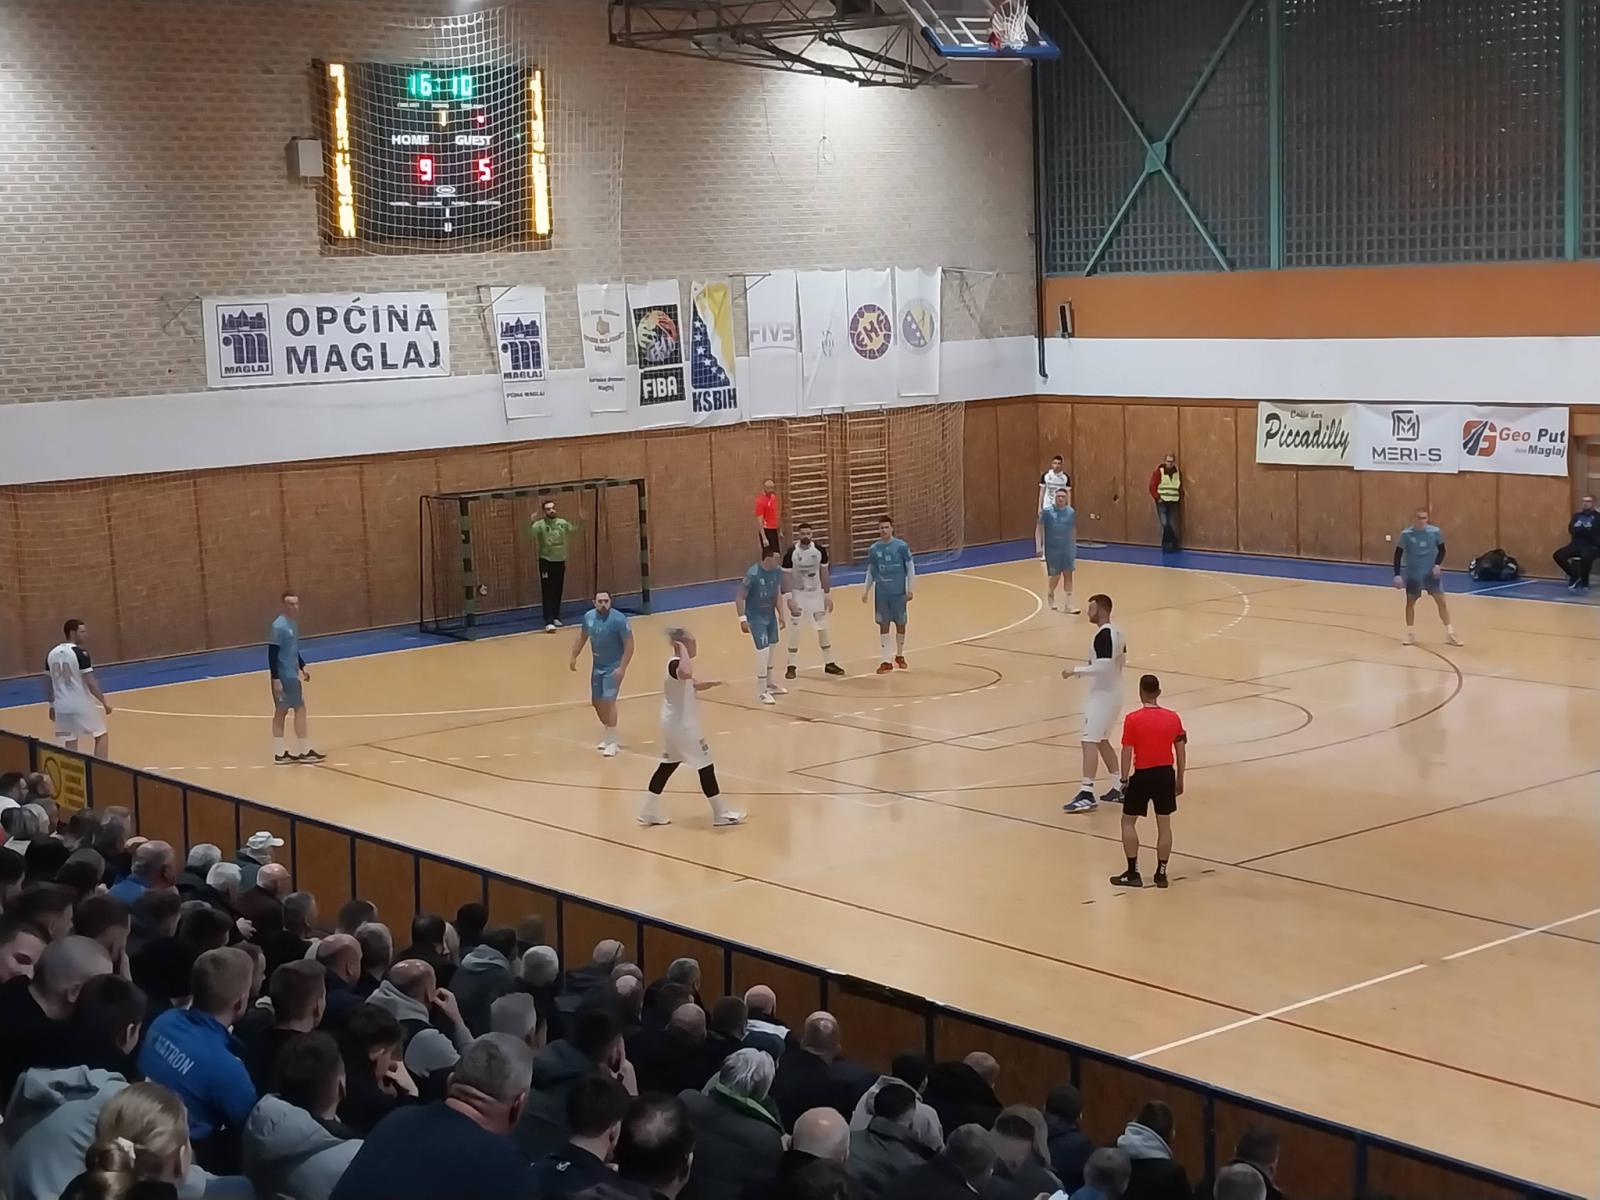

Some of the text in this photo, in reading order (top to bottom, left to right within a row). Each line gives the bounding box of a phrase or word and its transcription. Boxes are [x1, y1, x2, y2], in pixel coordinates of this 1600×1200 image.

[392, 134, 492, 145] HOME GUEST
[419, 158, 492, 181] 9 5
[285, 297, 438, 337] OPĆINA
[749, 323, 795, 343] FIVB
[285, 340, 441, 375] MAGLAJ
[224, 364, 270, 375] MAGLAJ
[503, 371, 543, 380] MAGLAJ
[642, 376, 678, 399] FIBA
[691, 388, 738, 413] KSBIH
[1263, 412, 1350, 460] Piccadilly
[1499, 427, 1566, 444] Geo Put
[1371, 446, 1442, 462] MERI-S
[1527, 444, 1566, 458] Maglaj
